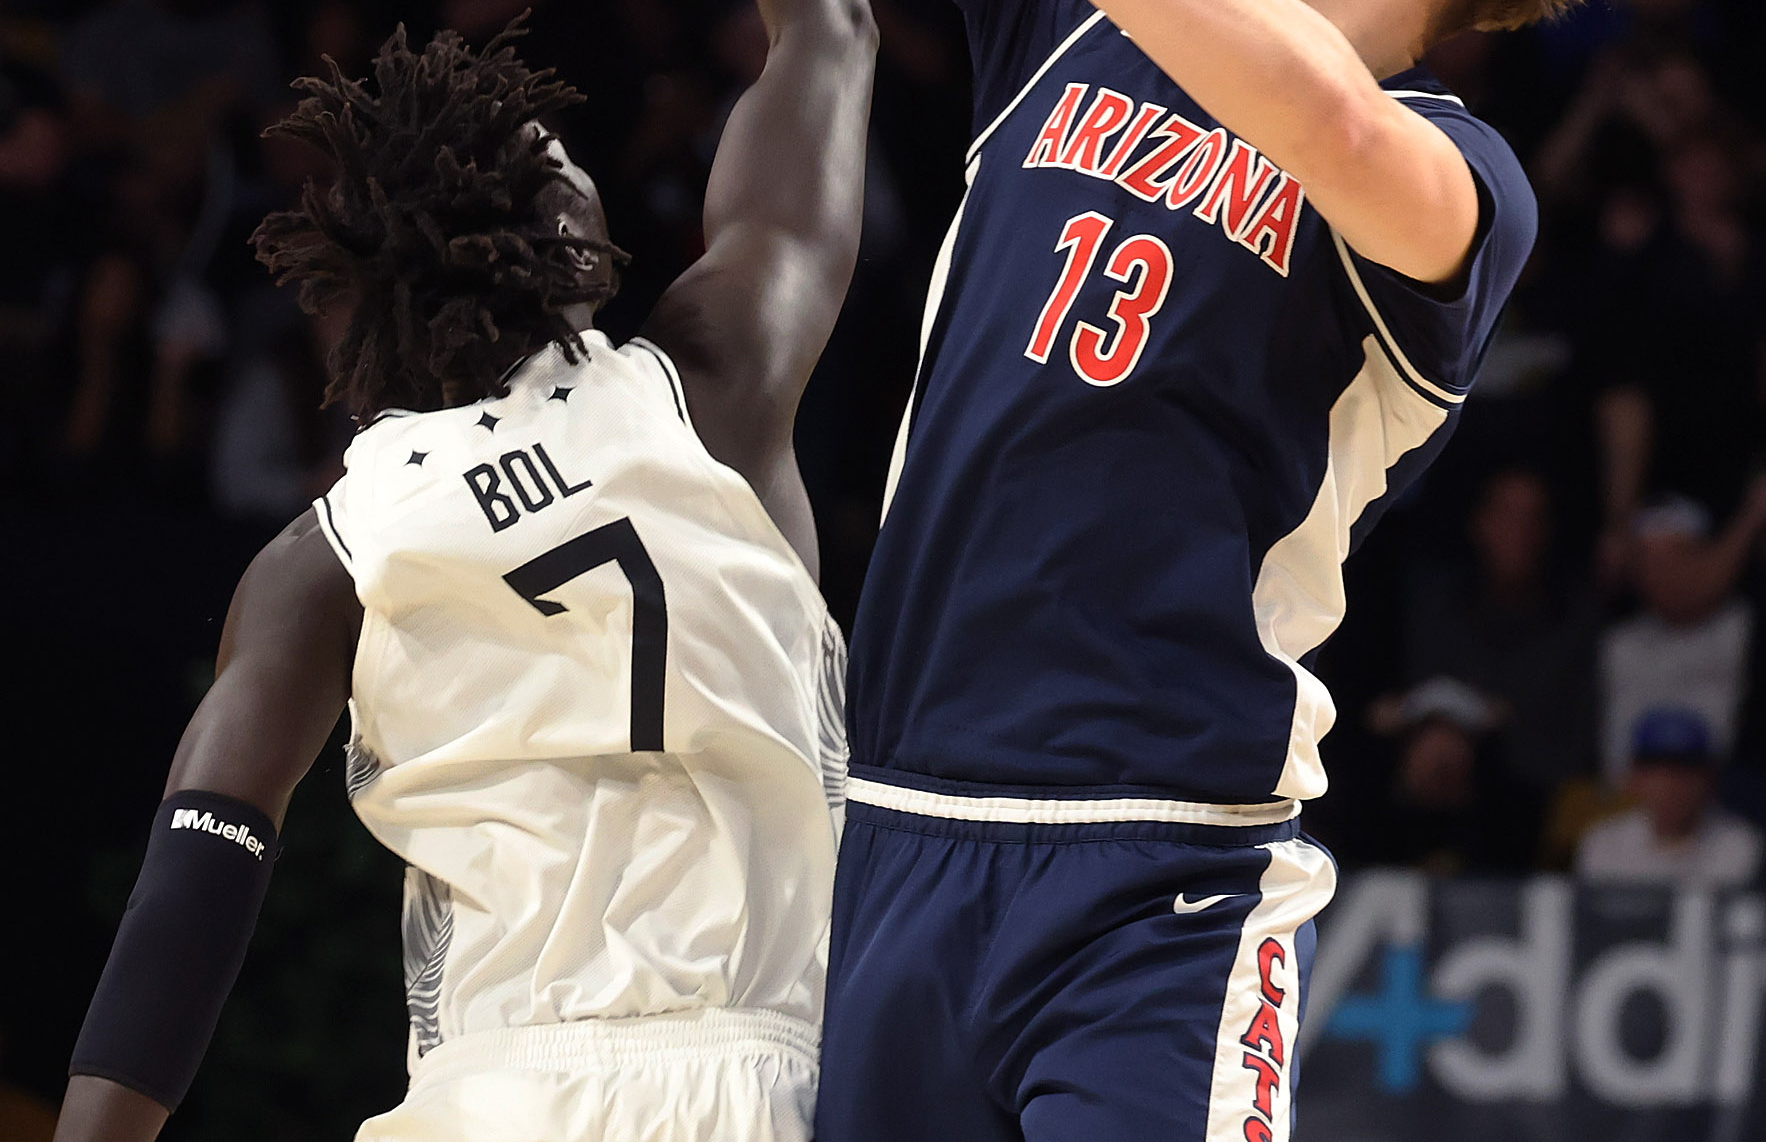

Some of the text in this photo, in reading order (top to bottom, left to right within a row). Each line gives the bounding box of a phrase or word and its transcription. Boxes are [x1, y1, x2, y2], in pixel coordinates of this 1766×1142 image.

[1021, 82, 1306, 278] ARIZONA
[1023, 210, 1175, 387] 13
[463, 443, 593, 533] BOL
[502, 516, 668, 753] 7
